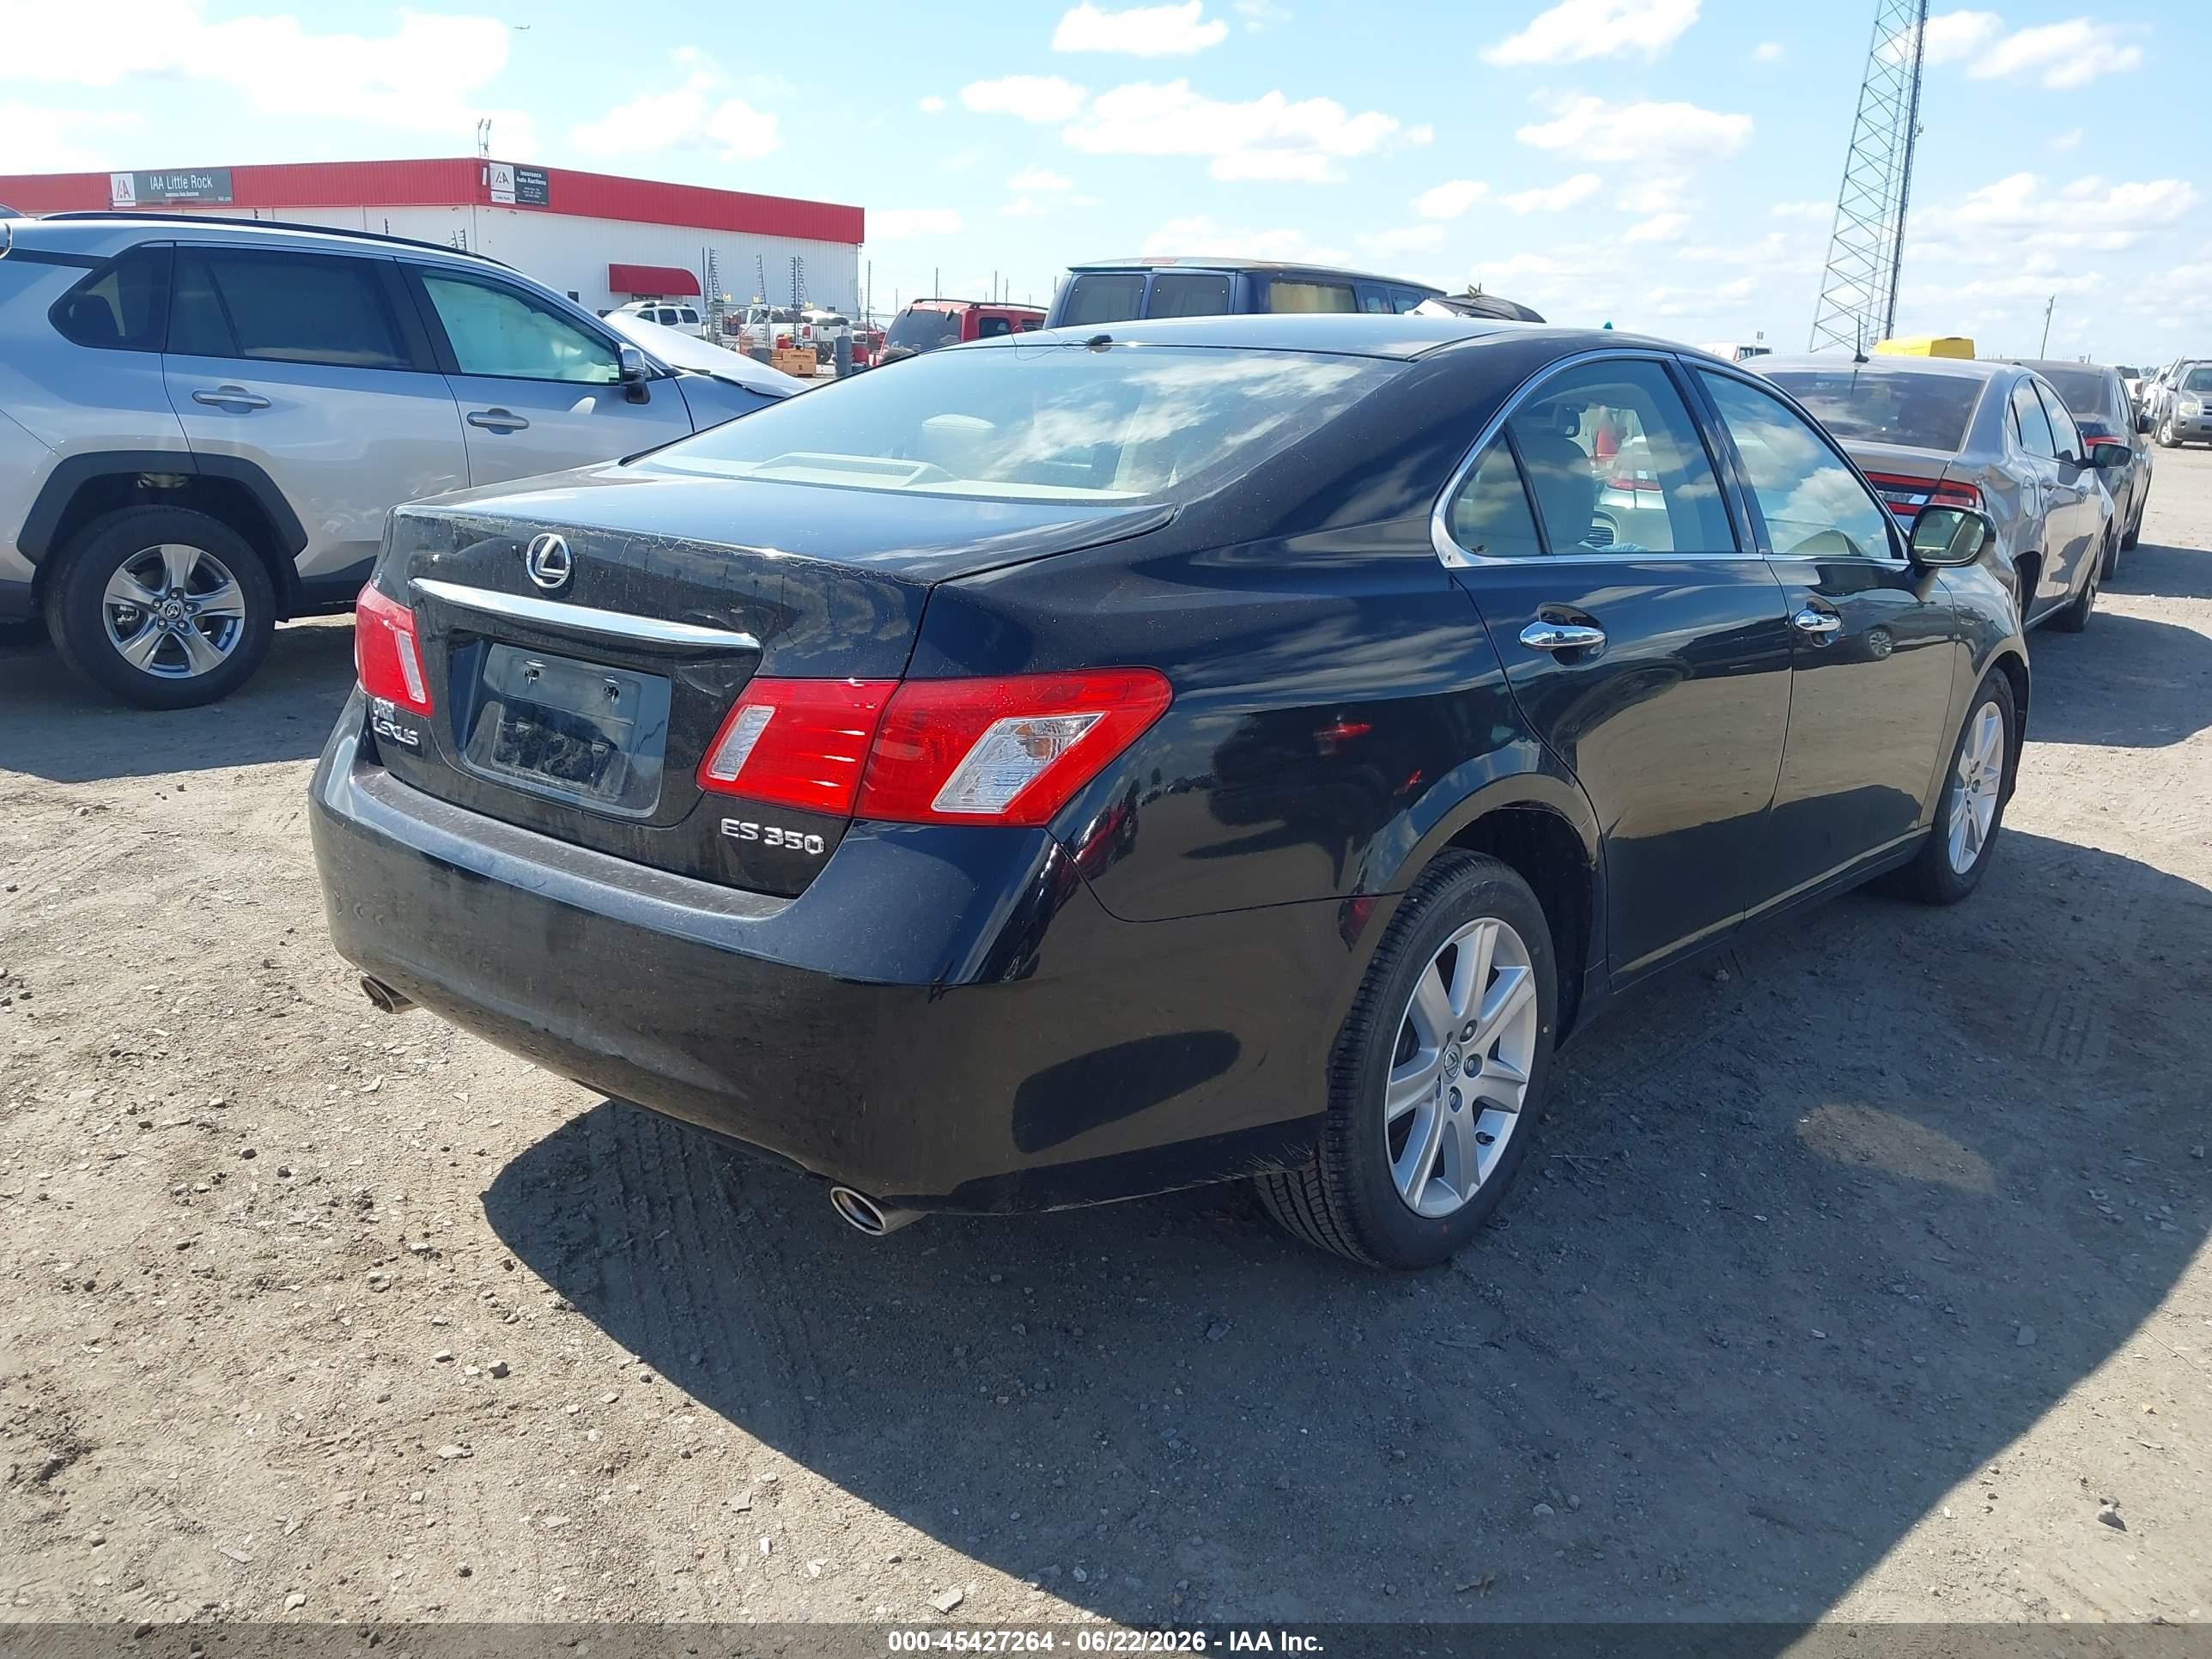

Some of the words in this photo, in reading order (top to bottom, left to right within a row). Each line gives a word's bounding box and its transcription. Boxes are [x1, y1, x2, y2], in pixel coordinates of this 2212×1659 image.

[149, 175, 165, 191] IAA
[166, 175, 189, 190] Little
[191, 174, 213, 189] Rock
[527, 177, 546, 185] Auctions
[372, 716, 419, 746] LEXUS
[721, 817, 759, 841] ES
[763, 826, 824, 854] 350
